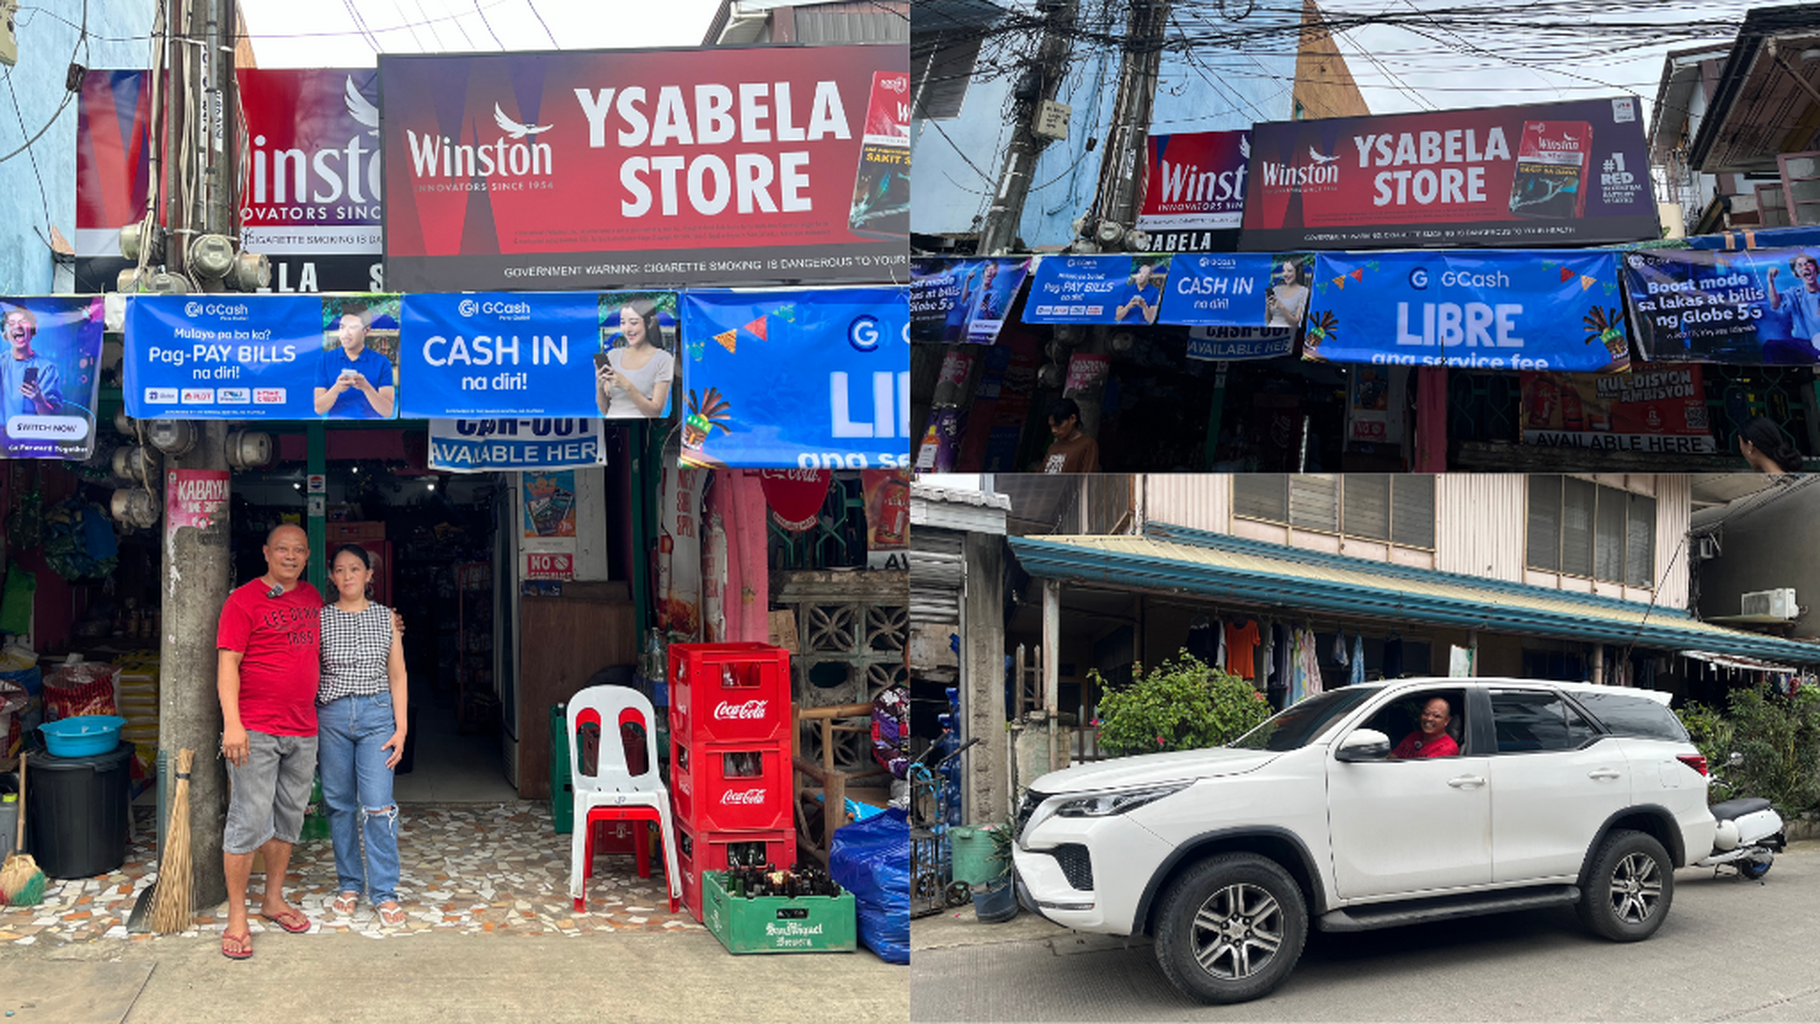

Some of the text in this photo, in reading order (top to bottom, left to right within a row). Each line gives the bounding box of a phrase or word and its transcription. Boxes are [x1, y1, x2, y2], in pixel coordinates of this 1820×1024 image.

[574, 81, 852, 147] YSABELA
[406, 129, 552, 177] Winston
[1353, 126, 1511, 167] YSABELA
[866, 152, 902, 165] SAKIT
[1603, 153, 1626, 173] #1
[1162, 160, 1248, 203] Winst
[1263, 161, 1338, 187] Winston
[1601, 172, 1634, 185] RED
[415, 181, 553, 192] INNOVATORS SINCE 1954
[620, 152, 812, 217] STORE
[1373, 167, 1487, 206] STORE
[240, 206, 327, 220] OVATORS
[1158, 202, 1222, 212] INNOVATORS
[307, 235, 354, 245] SMOKING
[357, 235, 366, 244] IS
[504, 255, 906, 277] GOVERNMENT WARNING: CIGARETTE SMOKING IS DANGEROUS TO YOUR
[1177, 277, 1254, 294] CASH IN
[1441, 271, 1510, 288] GCash
[1648, 273, 1749, 294] Boost mode
[482, 302, 530, 314] GCash
[1638, 287, 1765, 312] sa lakas at bilis
[206, 303, 248, 316] GCash
[1656, 303, 1763, 328] ng Globe 5G
[218, 331, 232, 340] pa
[234, 330, 249, 340] ba
[252, 329, 271, 340] ka?
[1396, 302, 1524, 348] LIBRE
[149, 344, 296, 366] Pag-PAY BILLS
[423, 335, 568, 366] CASH IN
[1187, 341, 1263, 355] AVAILABLE
[1422, 352, 1504, 369] service
[1510, 353, 1549, 371] fee
[193, 366, 240, 379] na diri!
[462, 372, 527, 390] na diri!
[1596, 369, 1692, 392] KUL-DISYON
[1620, 383, 1695, 403] AMBISYON
[17, 423, 76, 432] SWITCH NOW
[1536, 433, 1704, 452] AVAILABLE HERE
[178, 480, 229, 501] KABAYAN
[532, 556, 551, 570] NO
[263, 610, 288, 627] LEE
[287, 631, 314, 645] 1889
[714, 700, 768, 720] Coca-Cola
[720, 789, 766, 805] Coca-Cola
